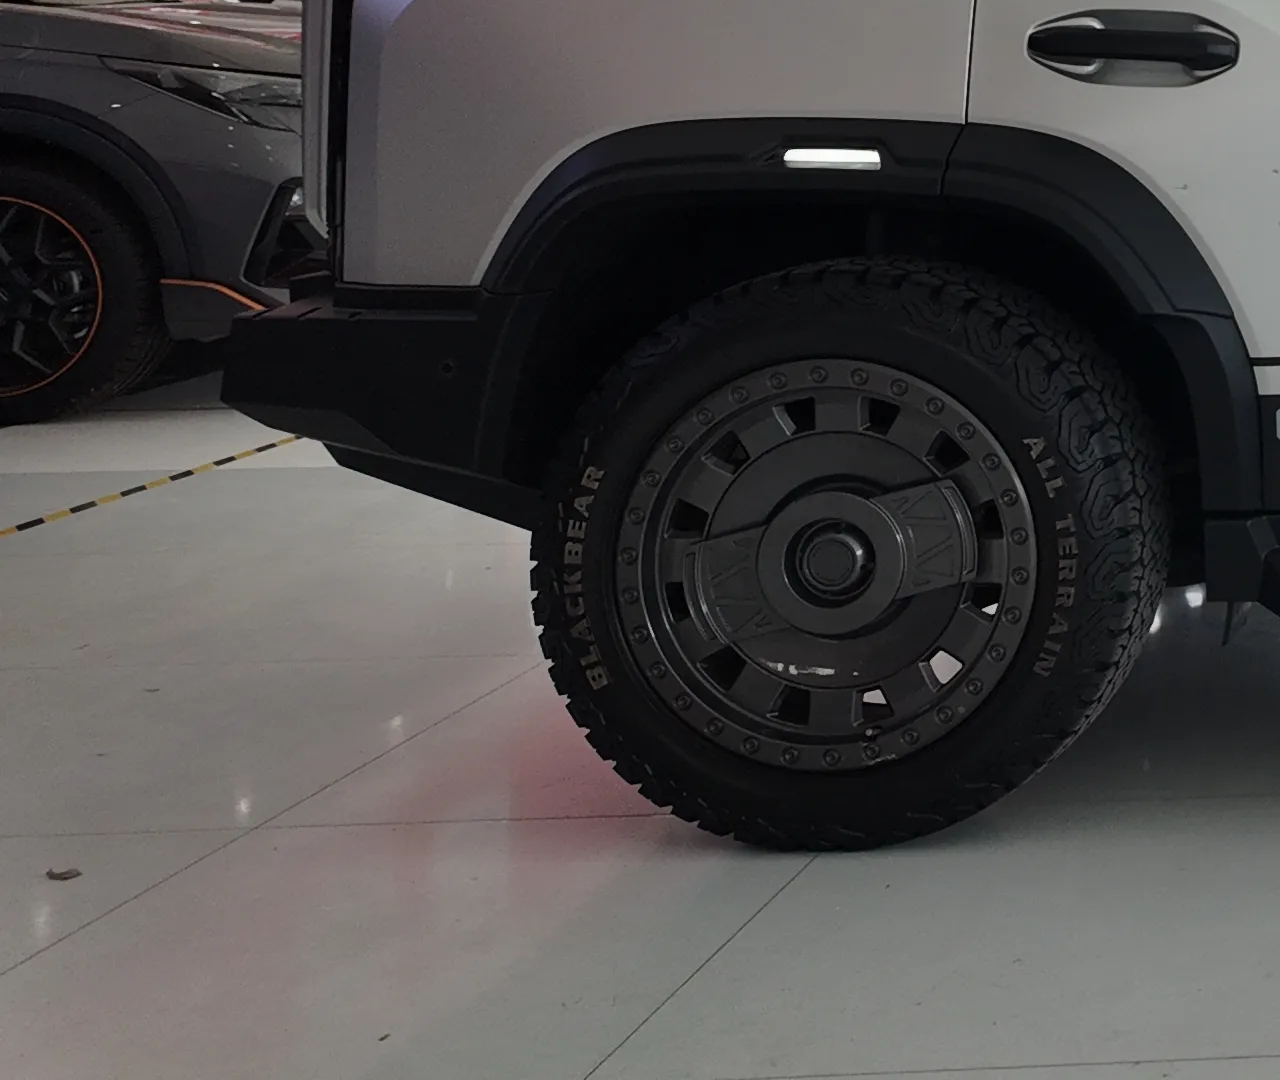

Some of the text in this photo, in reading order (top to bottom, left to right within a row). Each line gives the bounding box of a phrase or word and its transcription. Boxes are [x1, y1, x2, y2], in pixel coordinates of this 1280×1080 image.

[563, 466, 610, 691] BLACKBEAR
[1022, 436, 1079, 678] ALL TERRAIN
